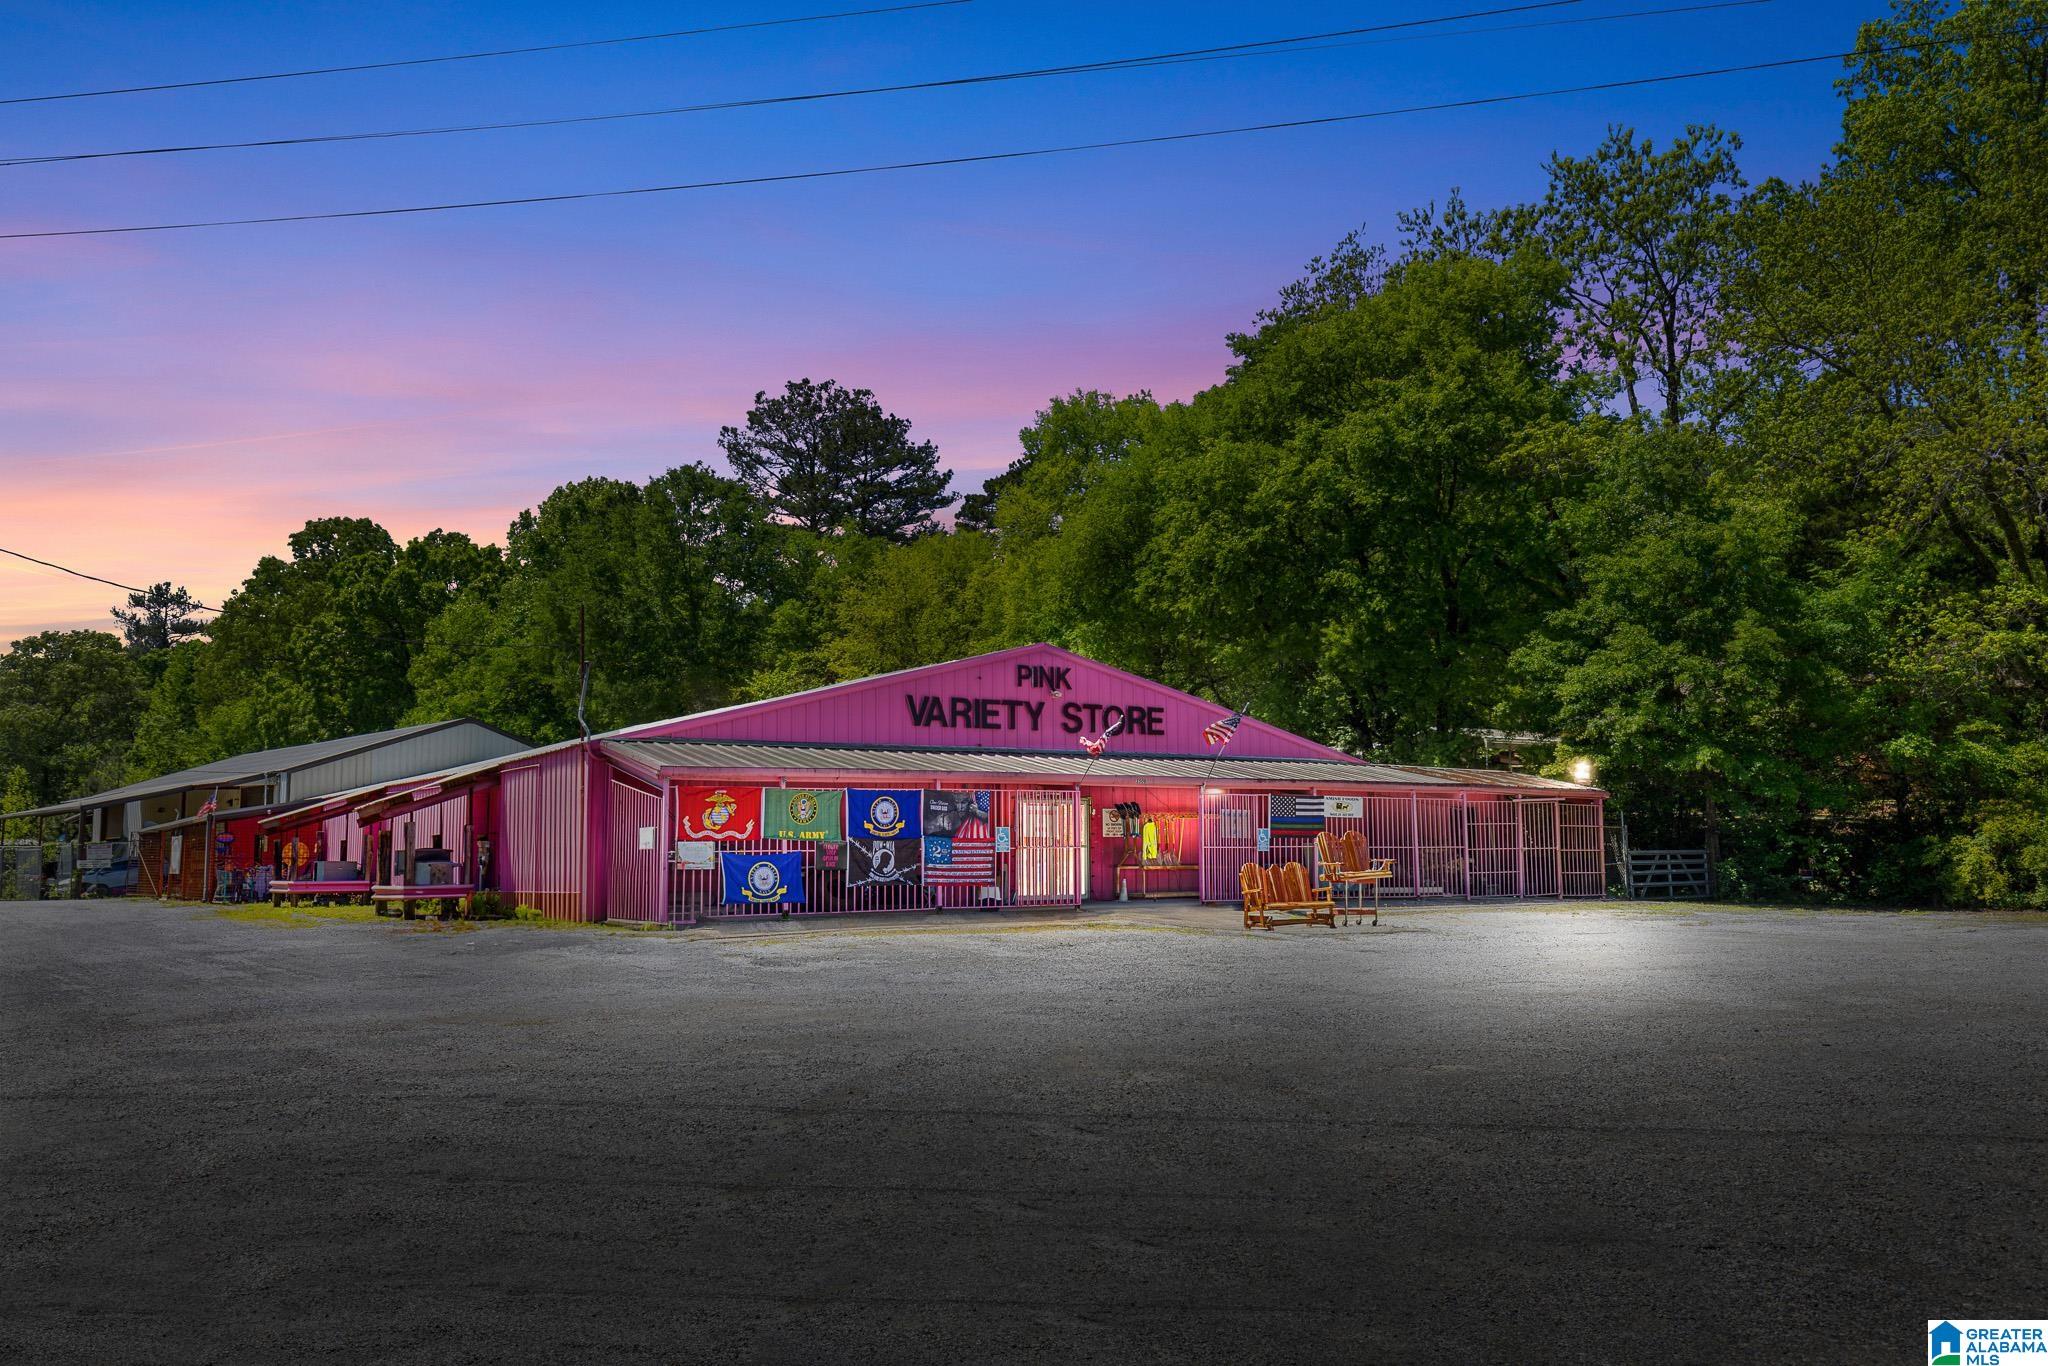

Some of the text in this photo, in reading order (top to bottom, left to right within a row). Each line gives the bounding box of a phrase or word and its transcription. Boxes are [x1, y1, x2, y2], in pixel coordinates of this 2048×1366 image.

[1017, 664, 1072, 690] PINK
[905, 694, 1165, 736] VARIETY STORE
[778, 830, 826, 840] U.S. ARMY
